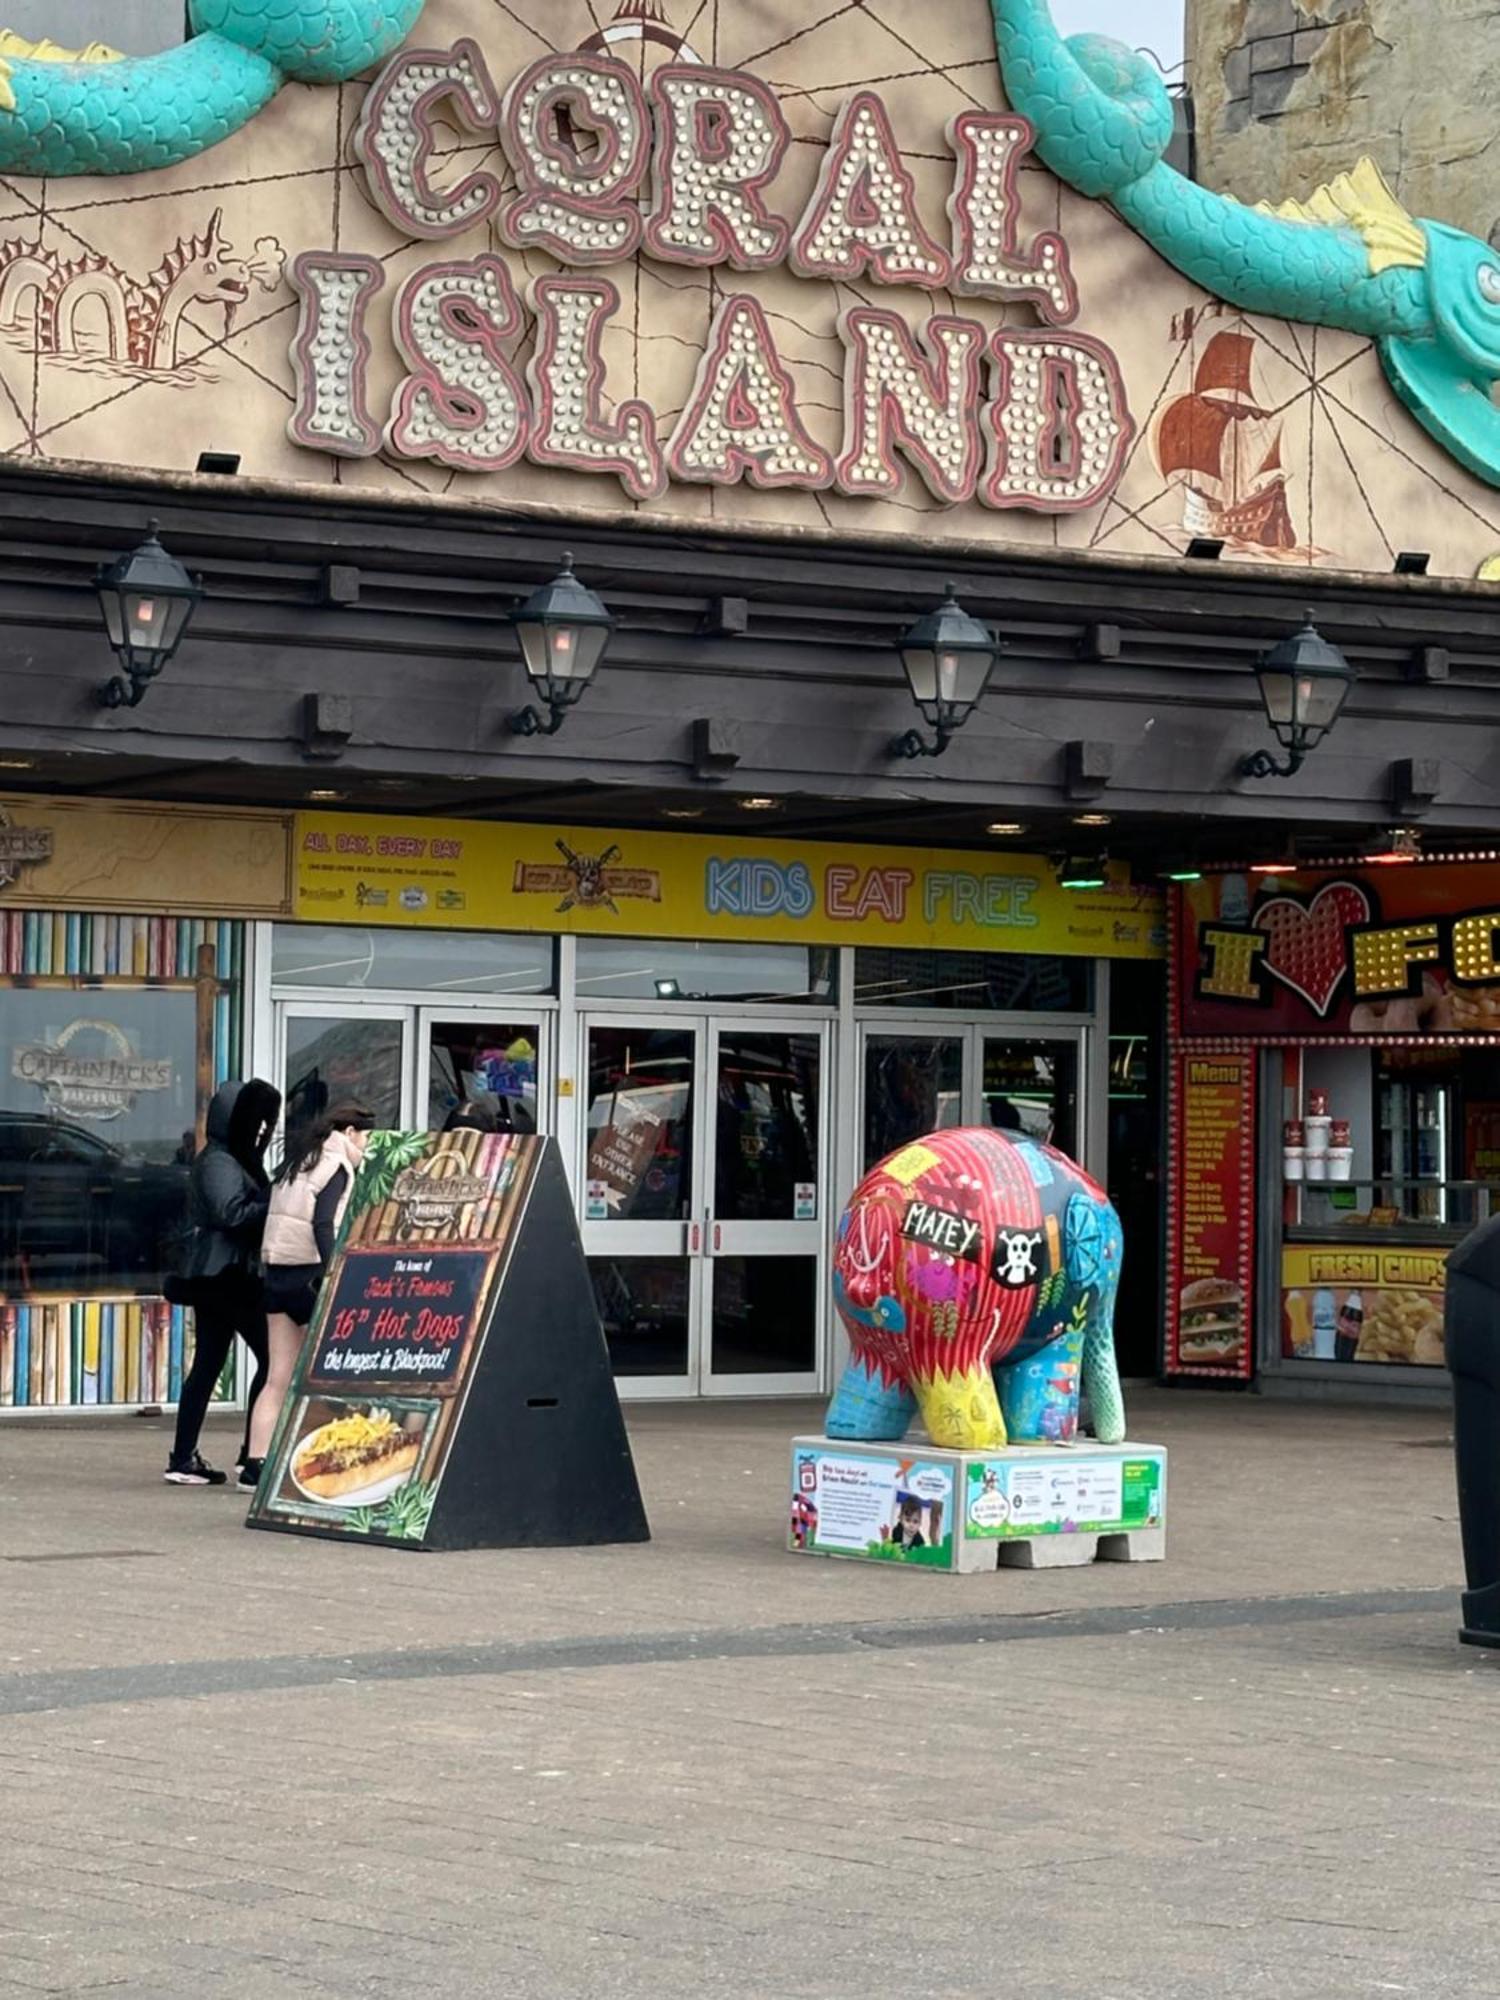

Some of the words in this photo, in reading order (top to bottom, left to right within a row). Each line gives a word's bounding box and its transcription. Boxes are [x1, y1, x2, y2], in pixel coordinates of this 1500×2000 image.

[357, 38, 1080, 325] CORAL
[287, 249, 1136, 514] ISLAND
[303, 832, 331, 852] ALL
[376, 836, 427, 858] EVERY
[431, 839, 463, 859] DAY
[706, 855, 815, 918] KIDS
[825, 864, 913, 924] EAT
[922, 869, 1041, 930] FREE
[19, 1051, 104, 1079] CAPTAIN
[109, 1059, 170, 1085] JACK'S
[1190, 1062, 1240, 1084] Menu
[591, 1153, 637, 1185] ENTRANCE
[603, 1146, 634, 1171] OTHER
[903, 1202, 979, 1254] MATEY
[394, 1260, 406, 1272] The
[423, 1259, 433, 1273] of
[1309, 1253, 1379, 1283] FRESH
[363, 1275, 406, 1299] Jack's
[407, 1275, 455, 1298] Famous
[371, 1306, 411, 1343] Hot
[412, 1306, 465, 1348] Dogs
[323, 1347, 343, 1371] the
[342, 1348, 381, 1375] longest
[379, 1347, 392, 1370] in
[391, 1347, 451, 1375] Blackpool!
